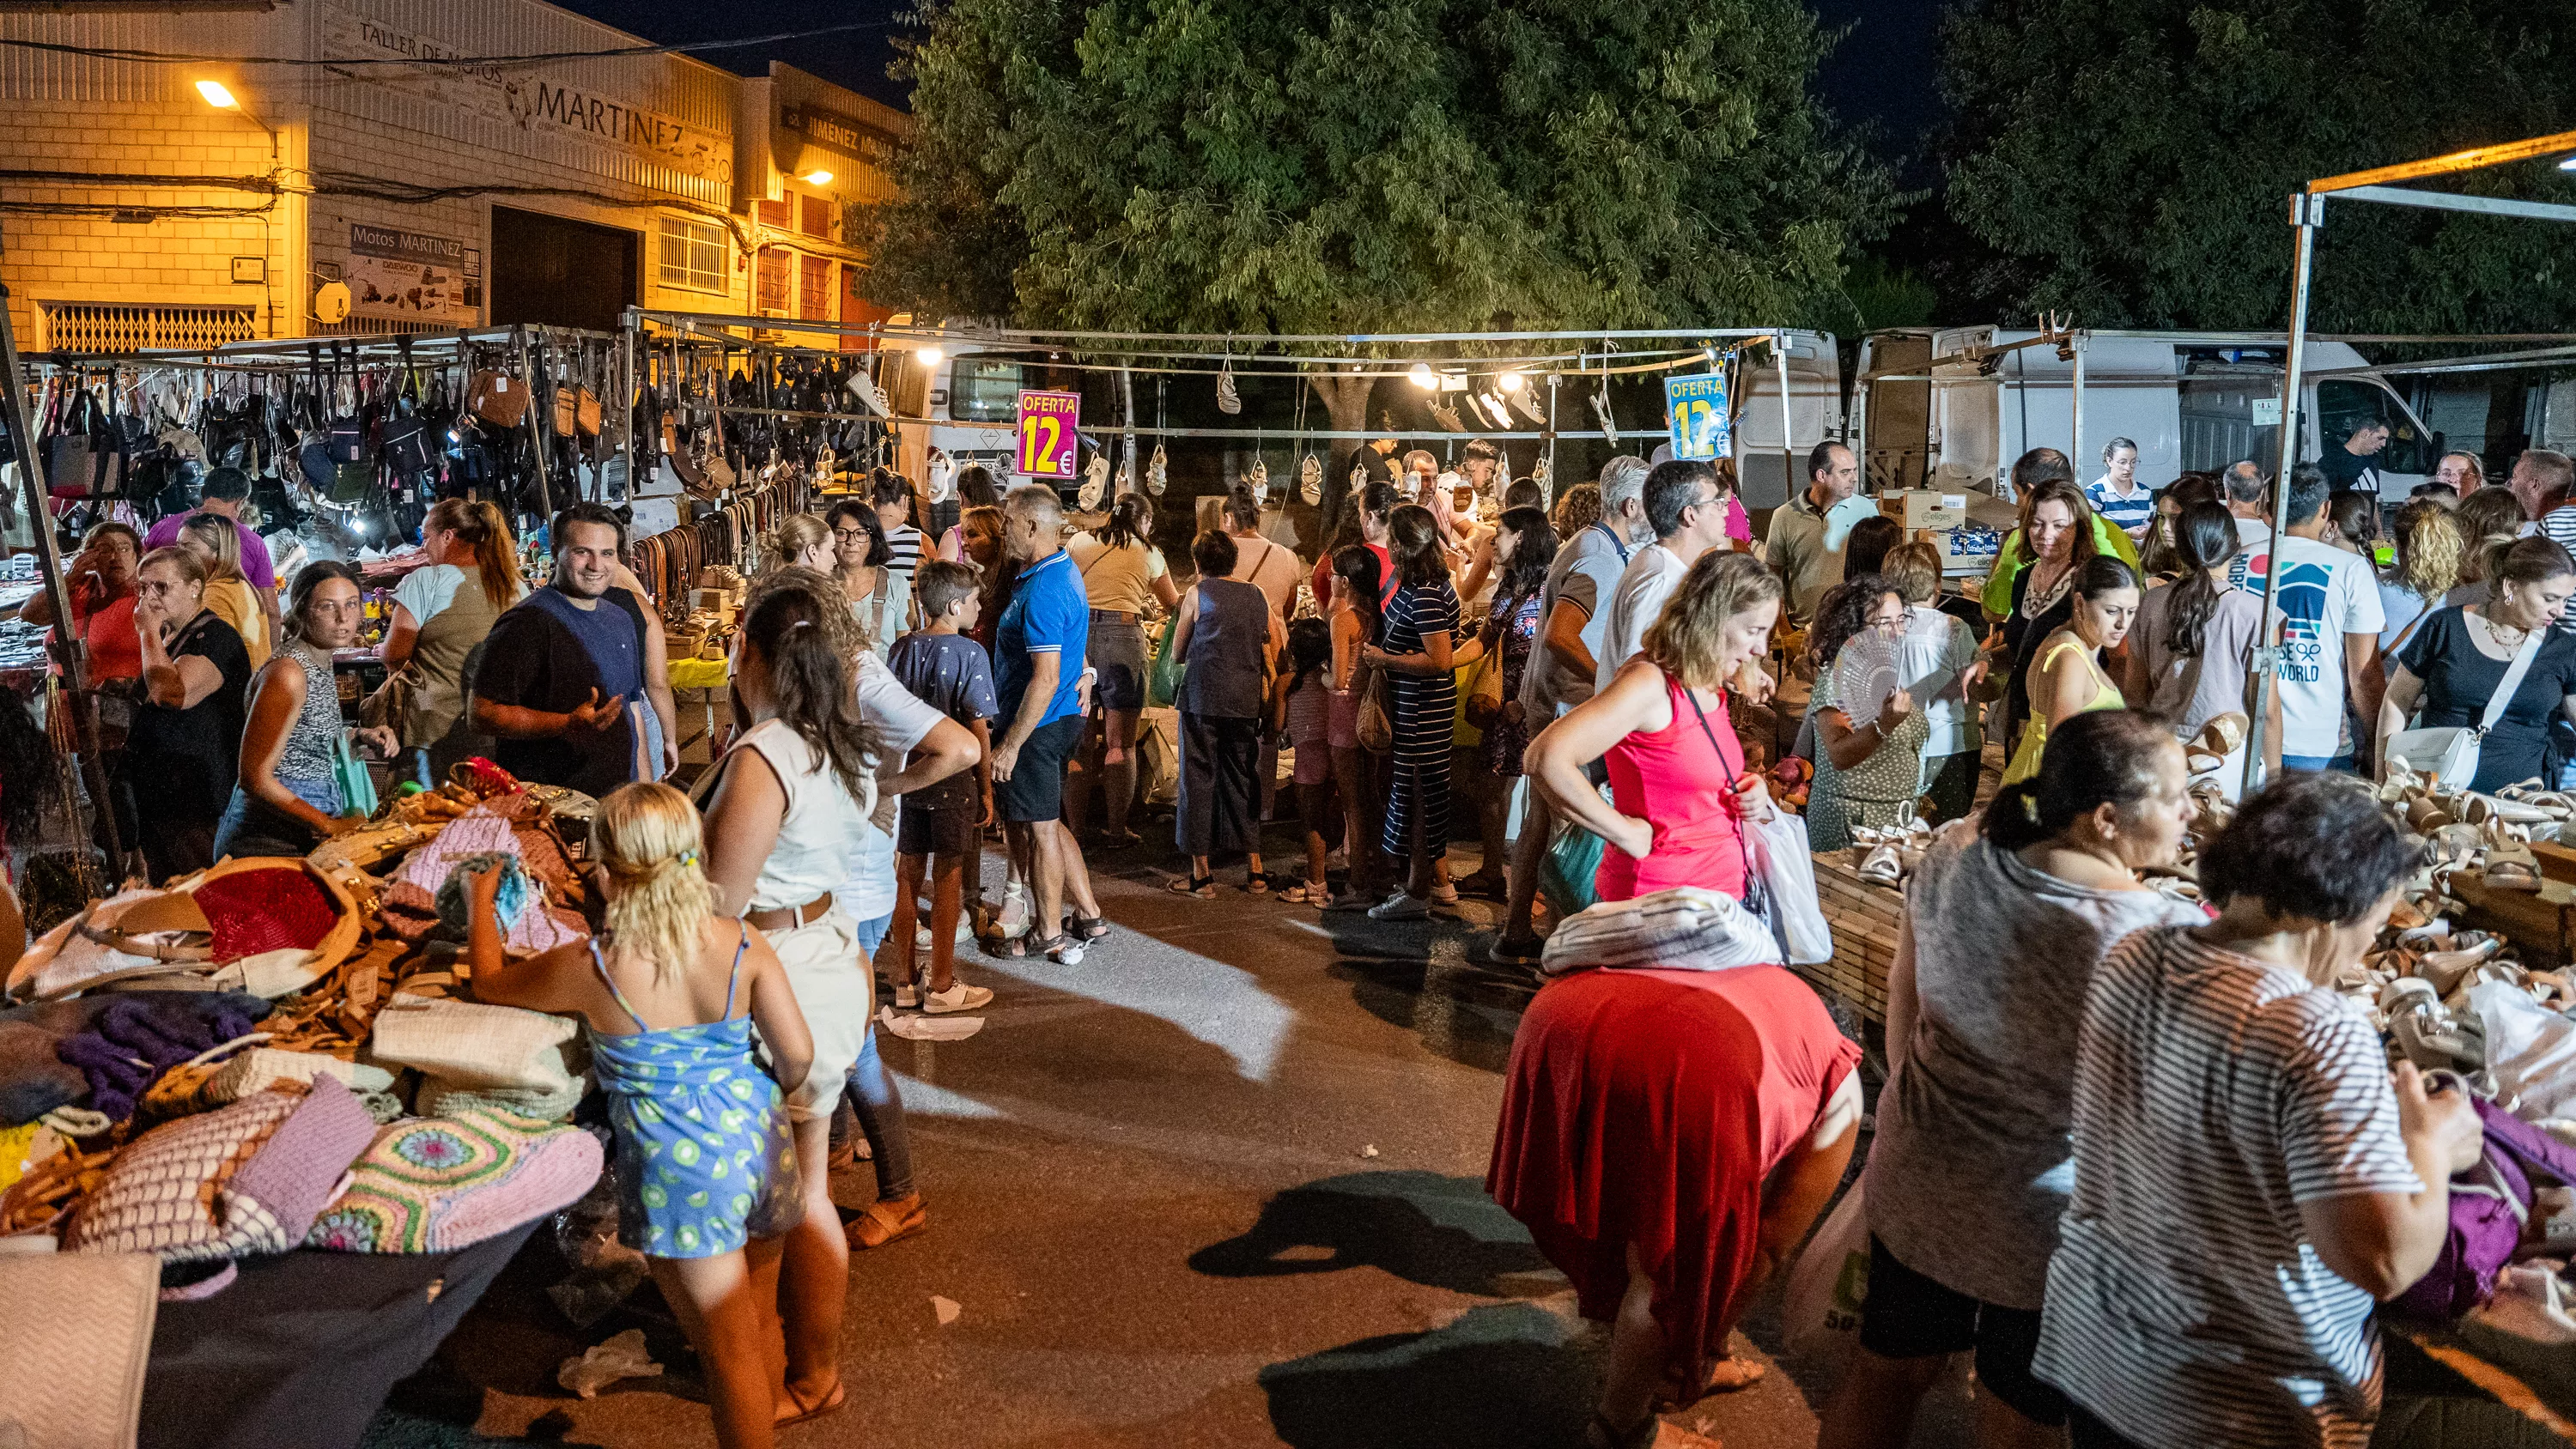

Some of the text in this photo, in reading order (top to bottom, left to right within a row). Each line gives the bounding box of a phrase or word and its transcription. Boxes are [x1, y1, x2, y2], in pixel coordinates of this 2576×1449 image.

[360, 22, 416, 58] TALLER
[422, 44, 441, 62] DE
[537, 82, 683, 158] MARTINEZ
[808, 116, 858, 150] JIMÉNEZ
[353, 227, 461, 258] Motos MARTINEZ
[382, 260, 418, 272] DAEWOO
[1670, 379, 1723, 397] OFERTA
[1023, 396, 1076, 414] OFERTA
[1977, 558, 1991, 567] elig
[2277, 664, 2319, 682] WORLD
